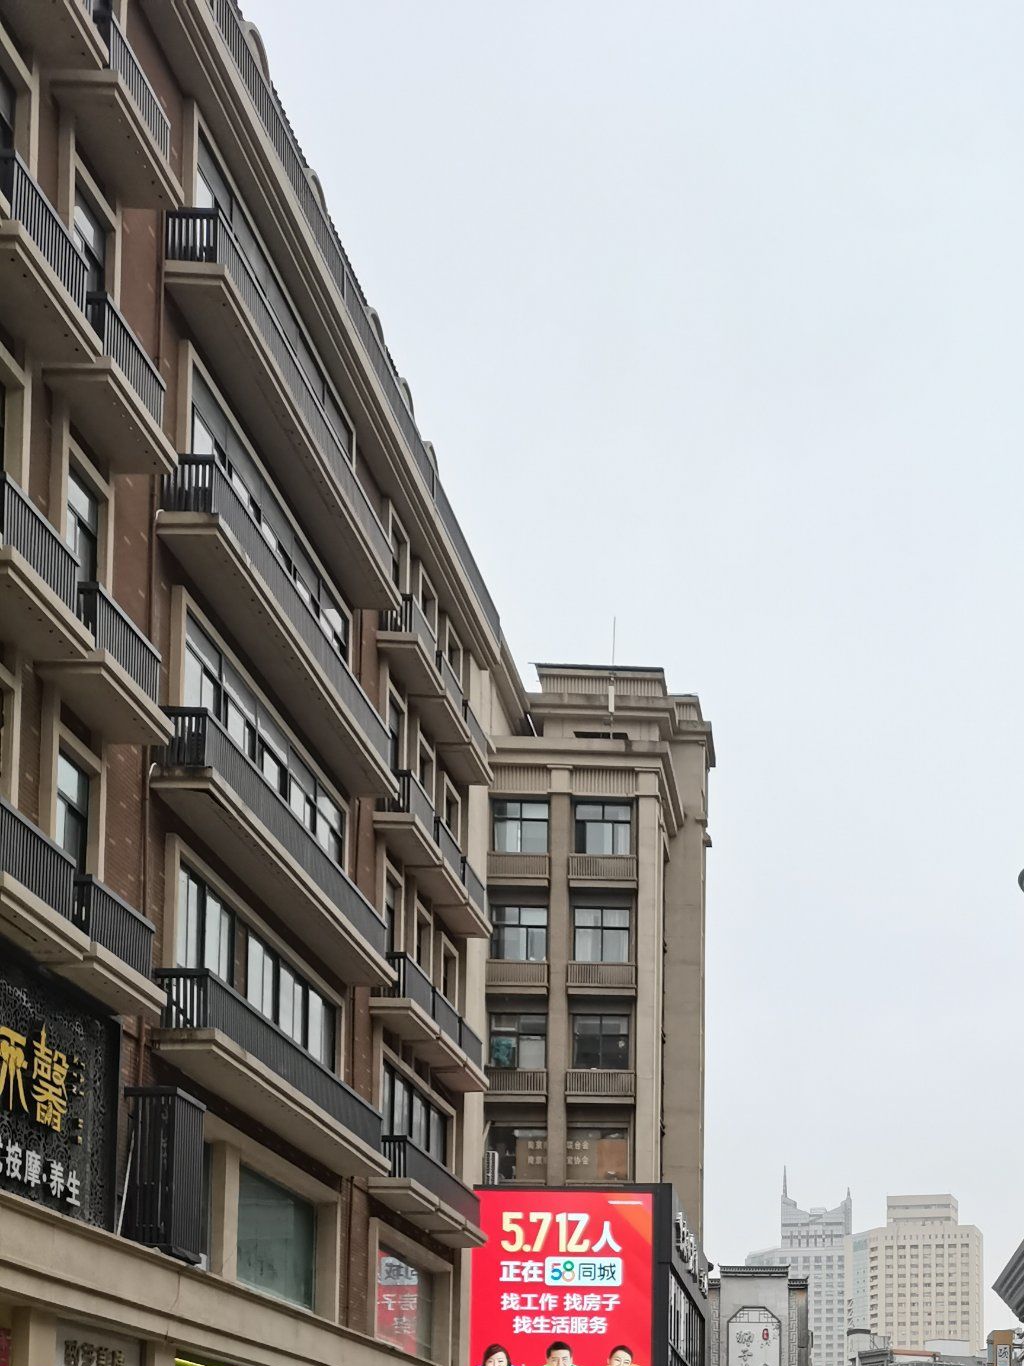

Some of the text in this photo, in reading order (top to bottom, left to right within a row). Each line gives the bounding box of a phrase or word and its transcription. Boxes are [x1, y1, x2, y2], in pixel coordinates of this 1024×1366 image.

[501, 1293, 620, 1311] 找工作 找房子
[512, 1316, 608, 1334] 找生活服务
